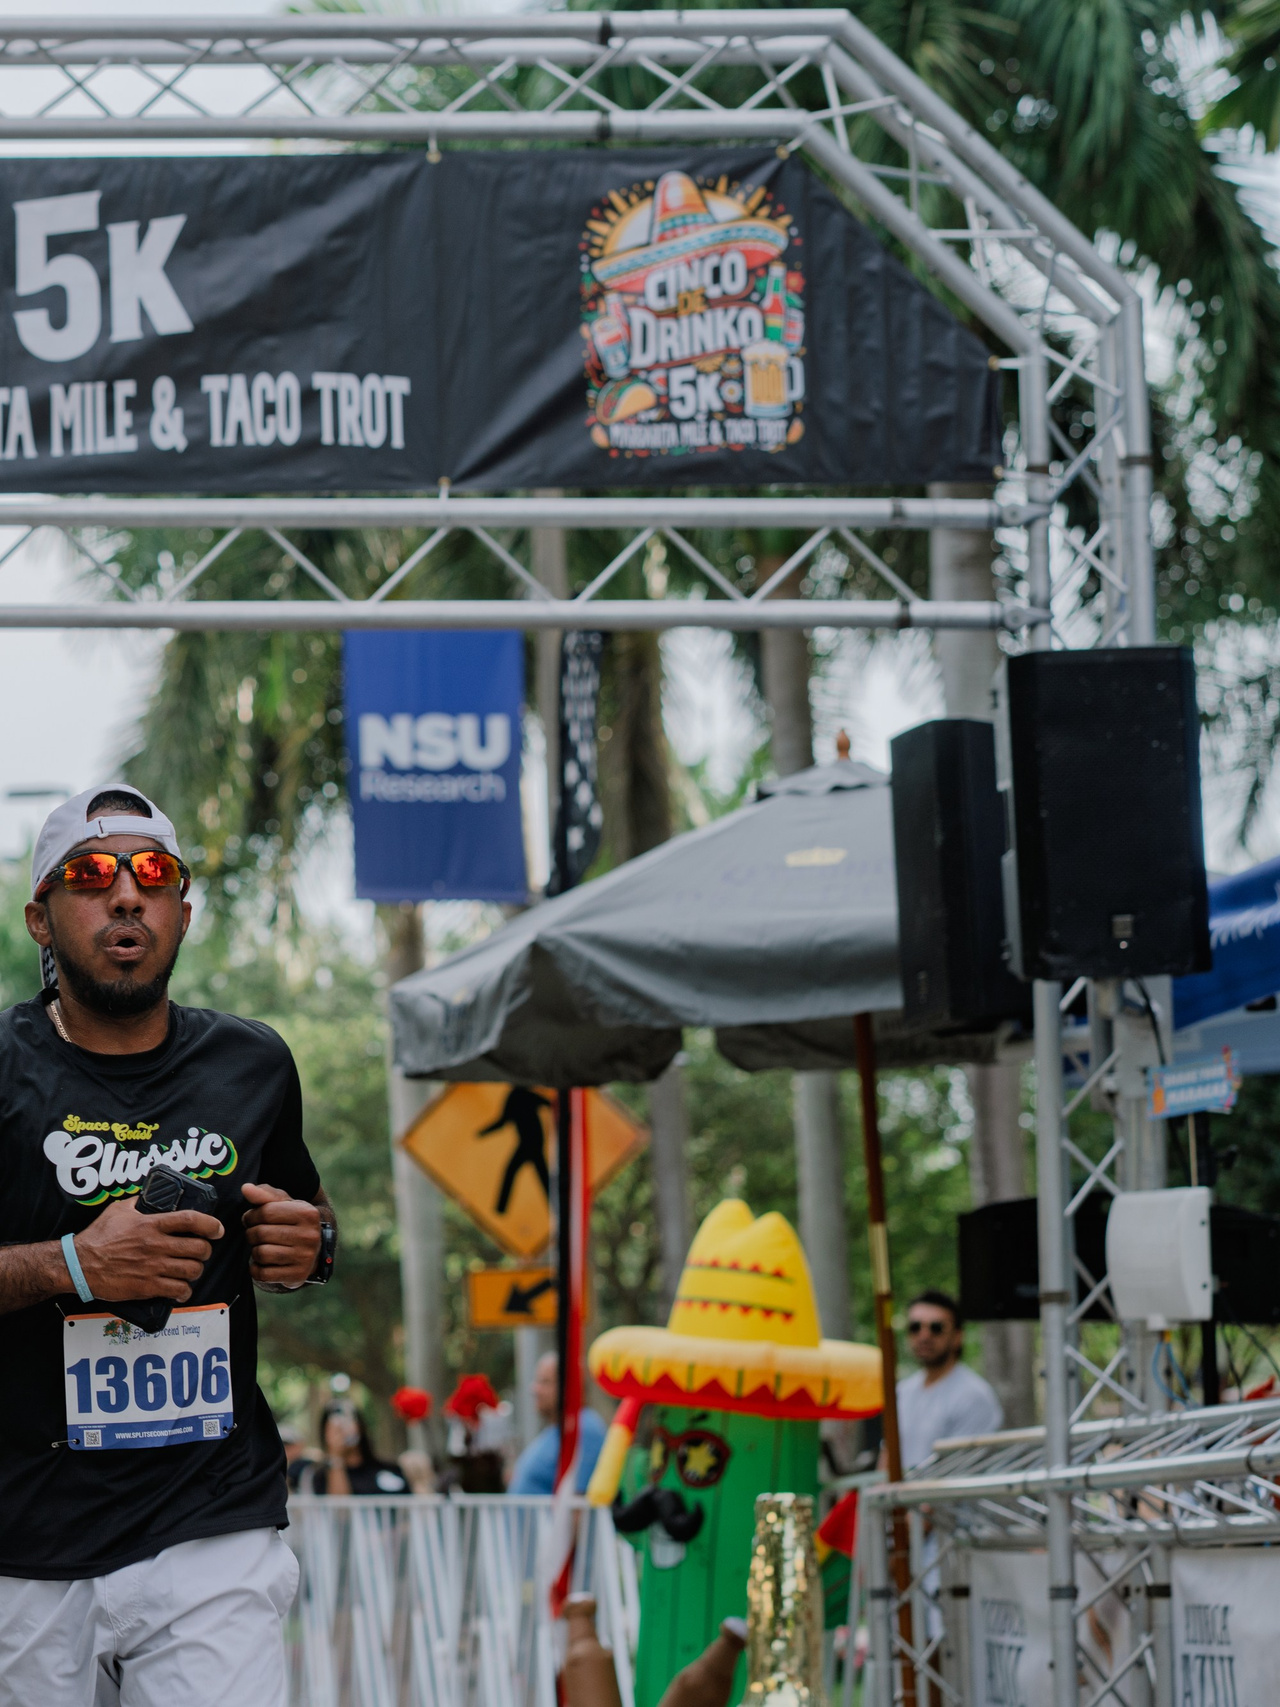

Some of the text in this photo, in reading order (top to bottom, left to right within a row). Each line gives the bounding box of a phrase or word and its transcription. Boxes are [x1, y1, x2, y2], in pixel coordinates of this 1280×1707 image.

[13, 190, 194, 362] 5K
[645, 251, 747, 310] CINCO
[676, 287, 708, 317] DE
[626, 305, 764, 369] DRINKO
[50, 380, 138, 457] MILE
[149, 376, 189, 453] &
[201, 371, 301, 448] TACO
[311, 371, 411, 449] TROT
[669, 364, 725, 420] 5K
[358, 712, 511, 772] NSU
[360, 770, 507, 802] Research
[63, 1114, 159, 1142] Space Coast
[43, 1127, 228, 1196] Classic
[181, 1325, 200, 1338] Timing
[66, 1347, 229, 1414] 13606
